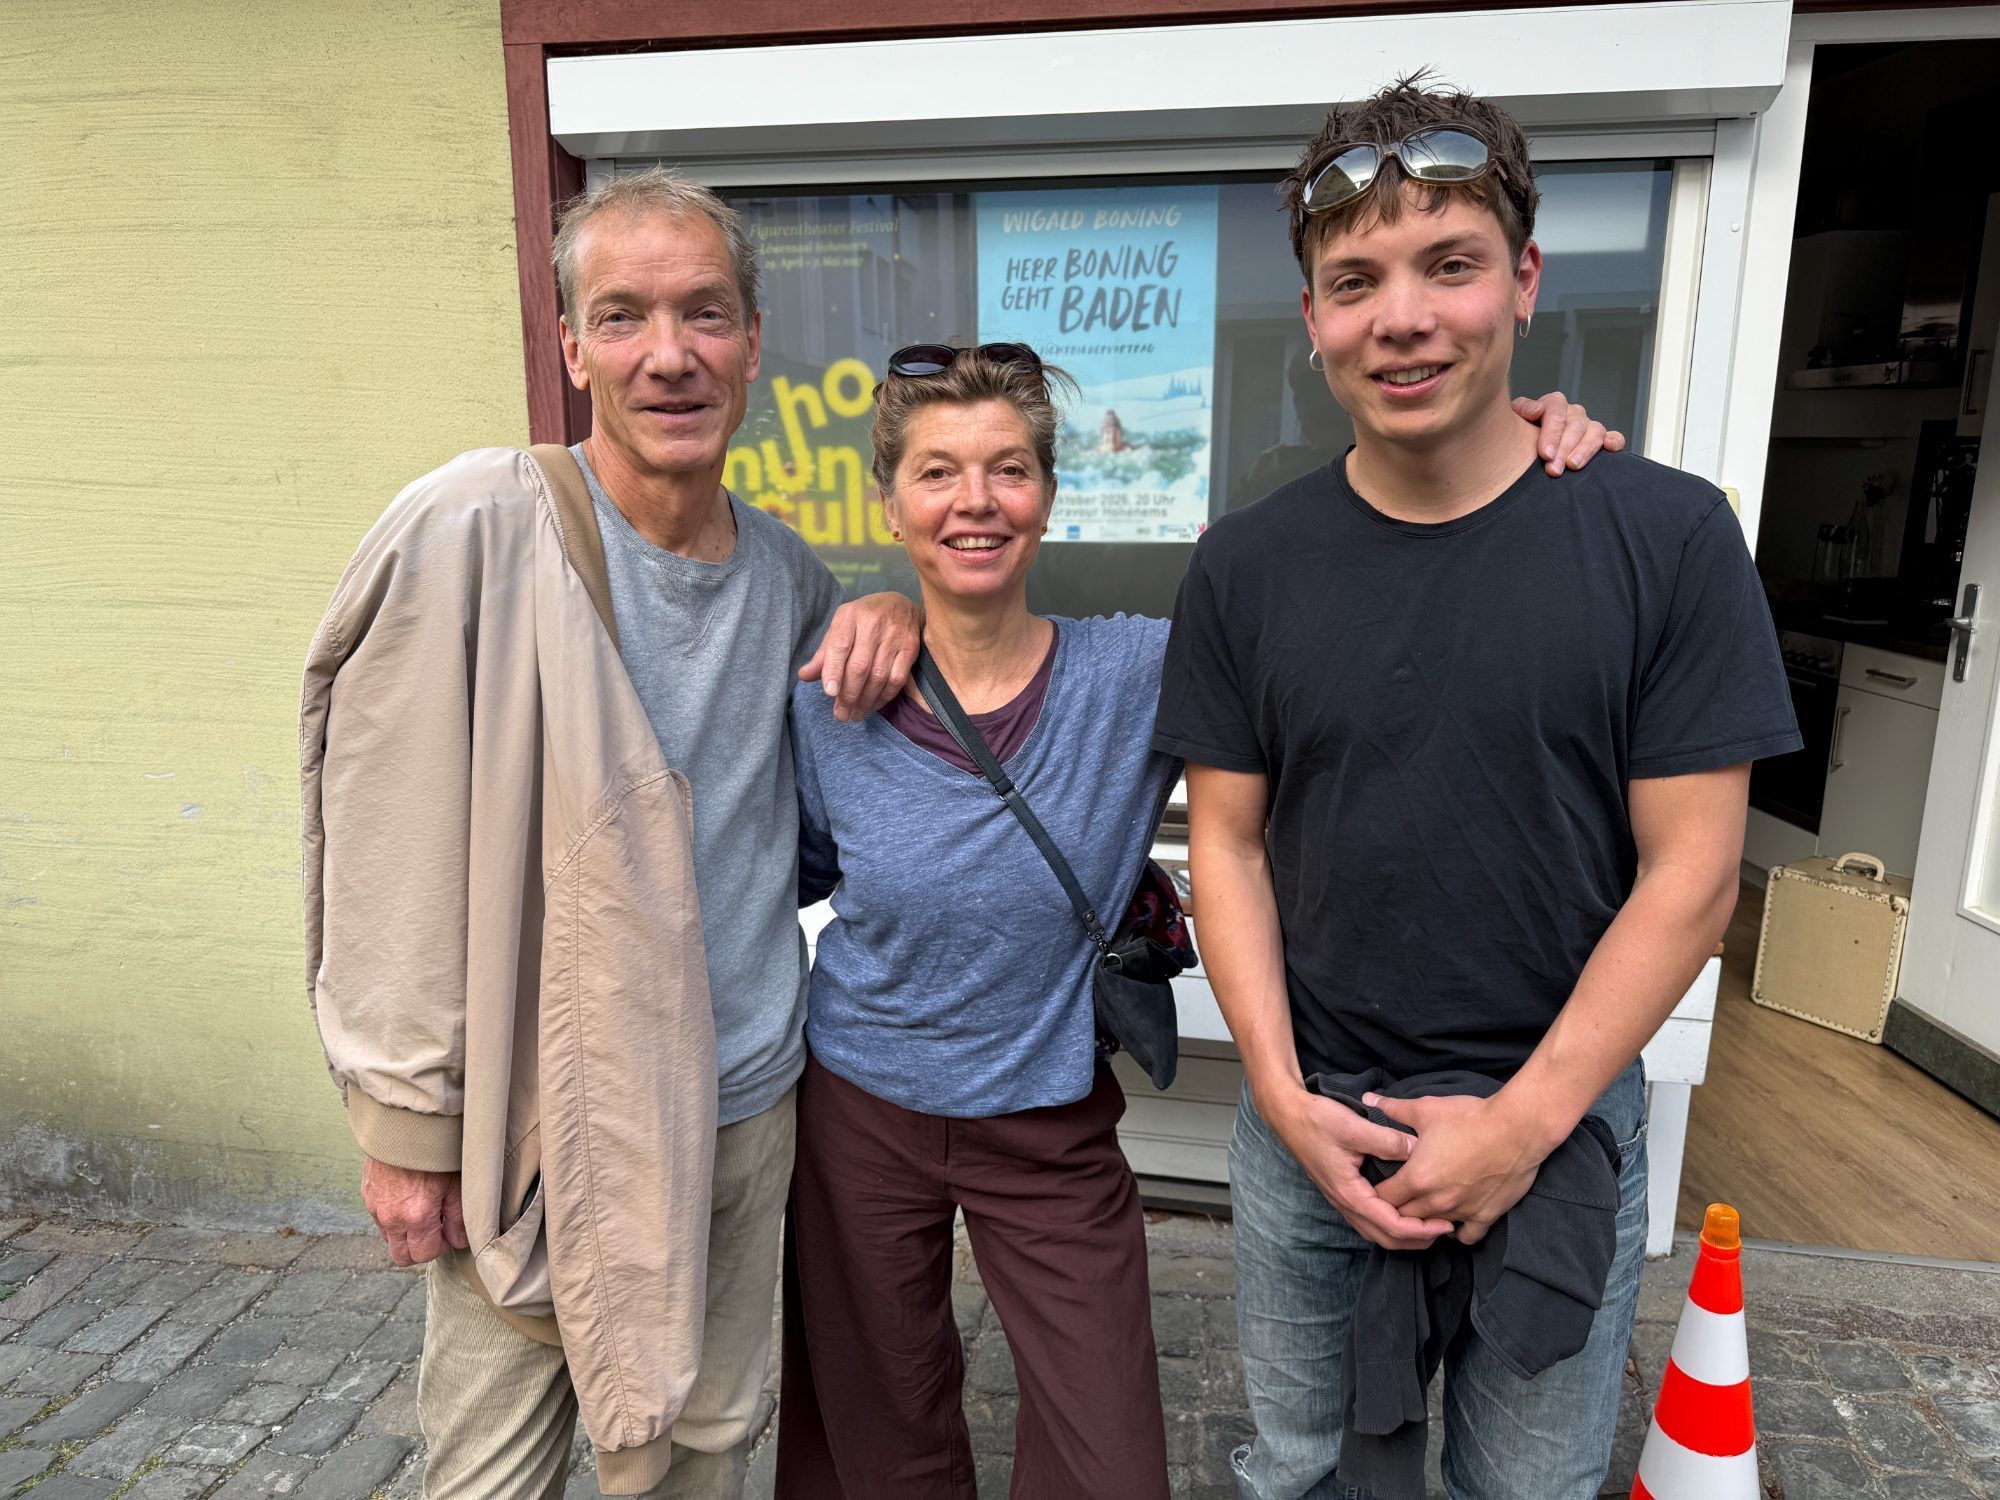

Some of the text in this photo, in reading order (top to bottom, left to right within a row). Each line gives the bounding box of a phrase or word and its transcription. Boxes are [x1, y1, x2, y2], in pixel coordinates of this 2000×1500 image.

[1003, 205, 1182, 233] WIGALD BONING
[1006, 241, 1179, 283] HERR BONING
[1001, 284, 1182, 334] GEHT BADEN
[1056, 494, 1097, 506] ktober
[1153, 493, 1176, 506] Uhr
